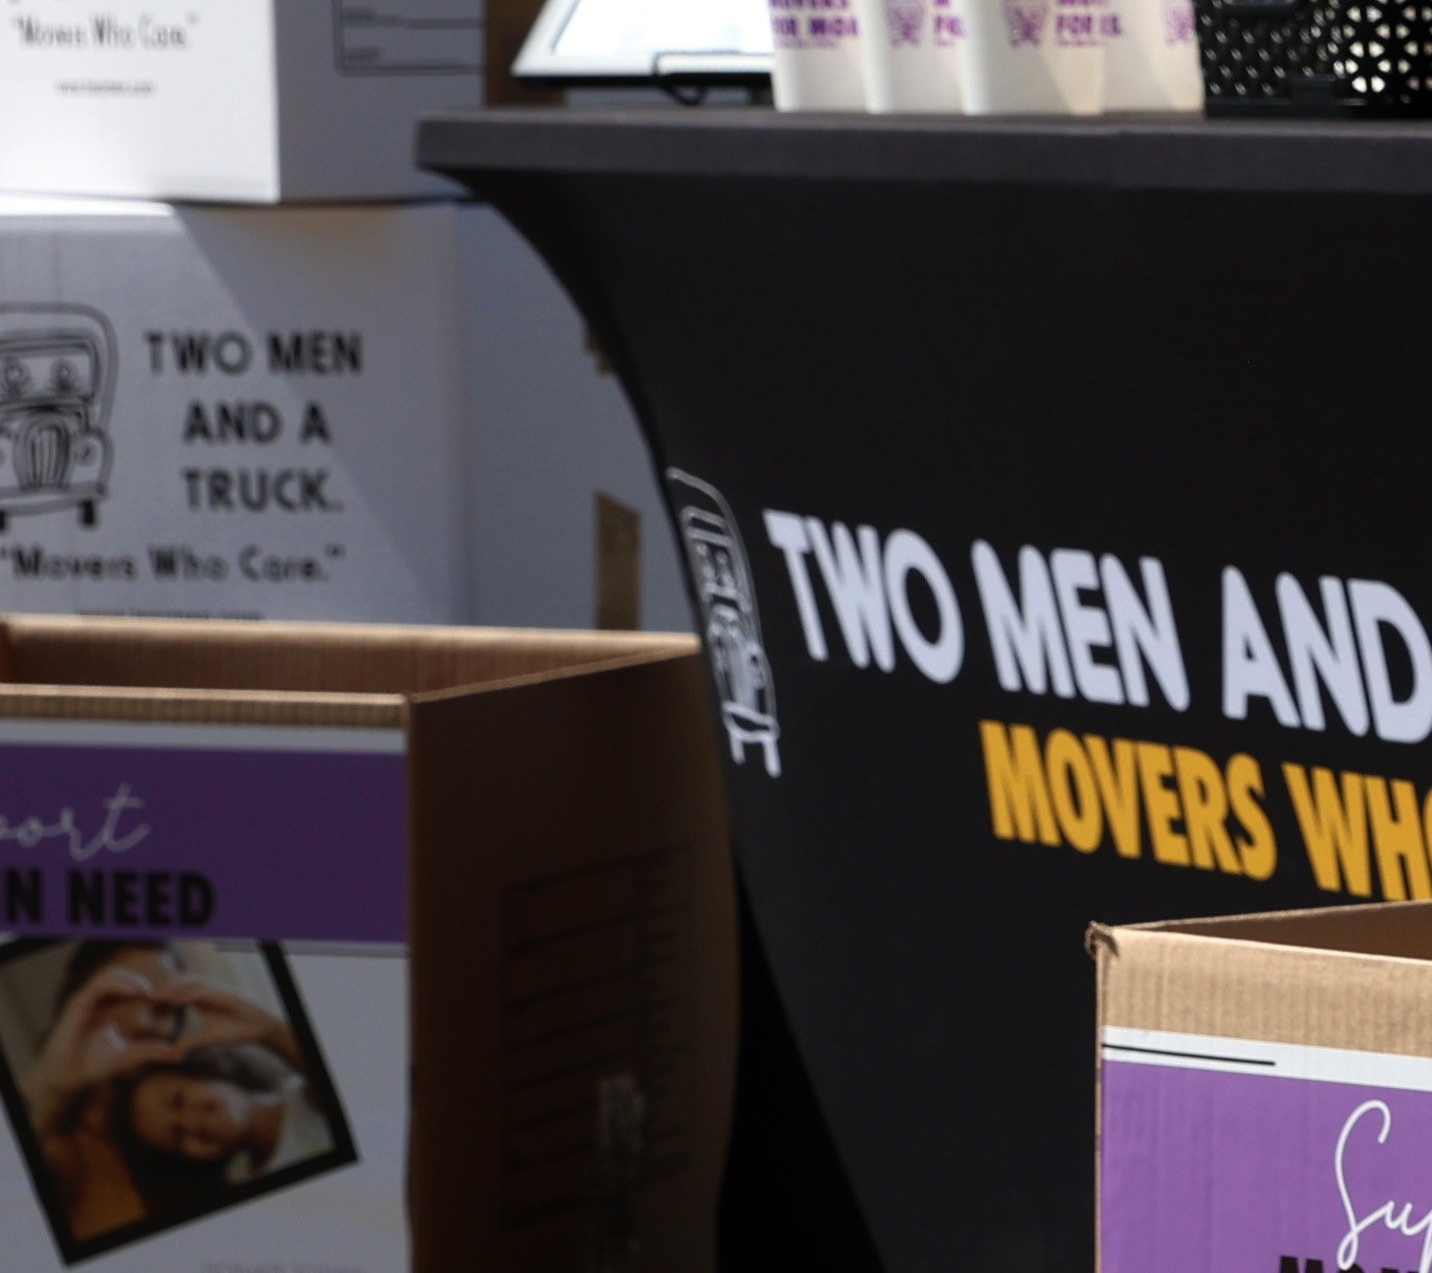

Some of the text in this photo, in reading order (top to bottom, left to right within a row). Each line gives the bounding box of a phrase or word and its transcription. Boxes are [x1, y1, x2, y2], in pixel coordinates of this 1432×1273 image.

[143, 331, 362, 376] TWO MEN
[182, 398, 332, 445] AND A
[147, 542, 229, 581] Who
[763, 508, 963, 684] TWO
[972, 539, 1189, 711] MEN
[980, 719, 1276, 881] MOVERS
[68, 868, 216, 925] NEED
